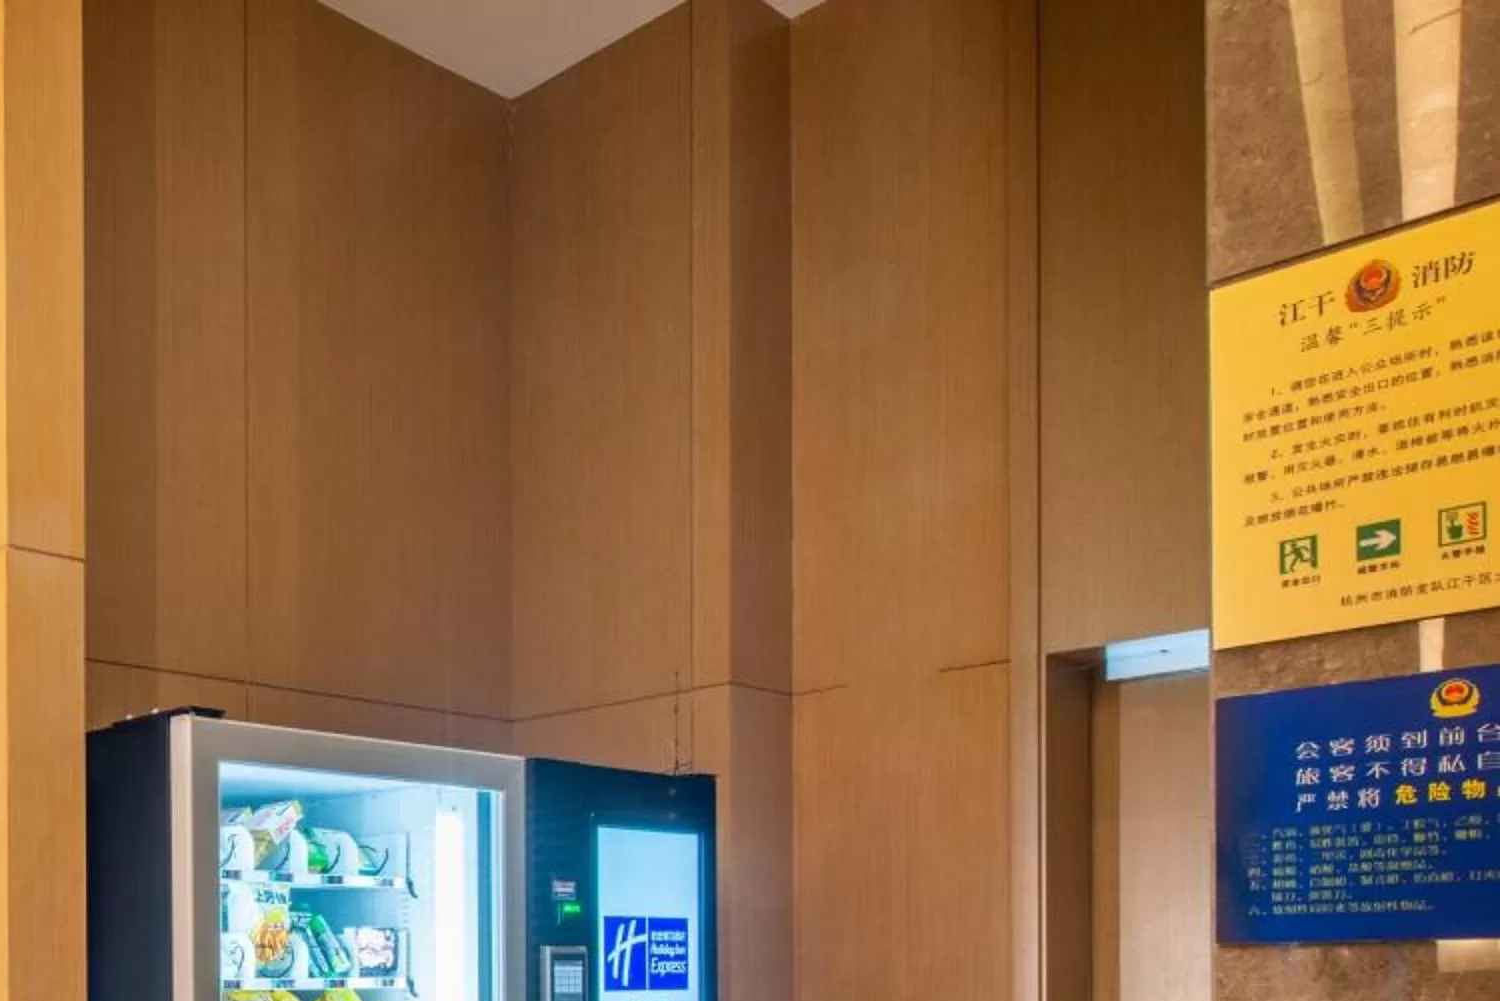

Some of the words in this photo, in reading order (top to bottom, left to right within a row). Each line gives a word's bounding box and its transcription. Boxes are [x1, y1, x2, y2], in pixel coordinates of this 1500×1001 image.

[1413, 252, 1475, 288] 消防
[1295, 778, 1500, 813] 严禁将危险物
[651, 957, 686, 978] Express
